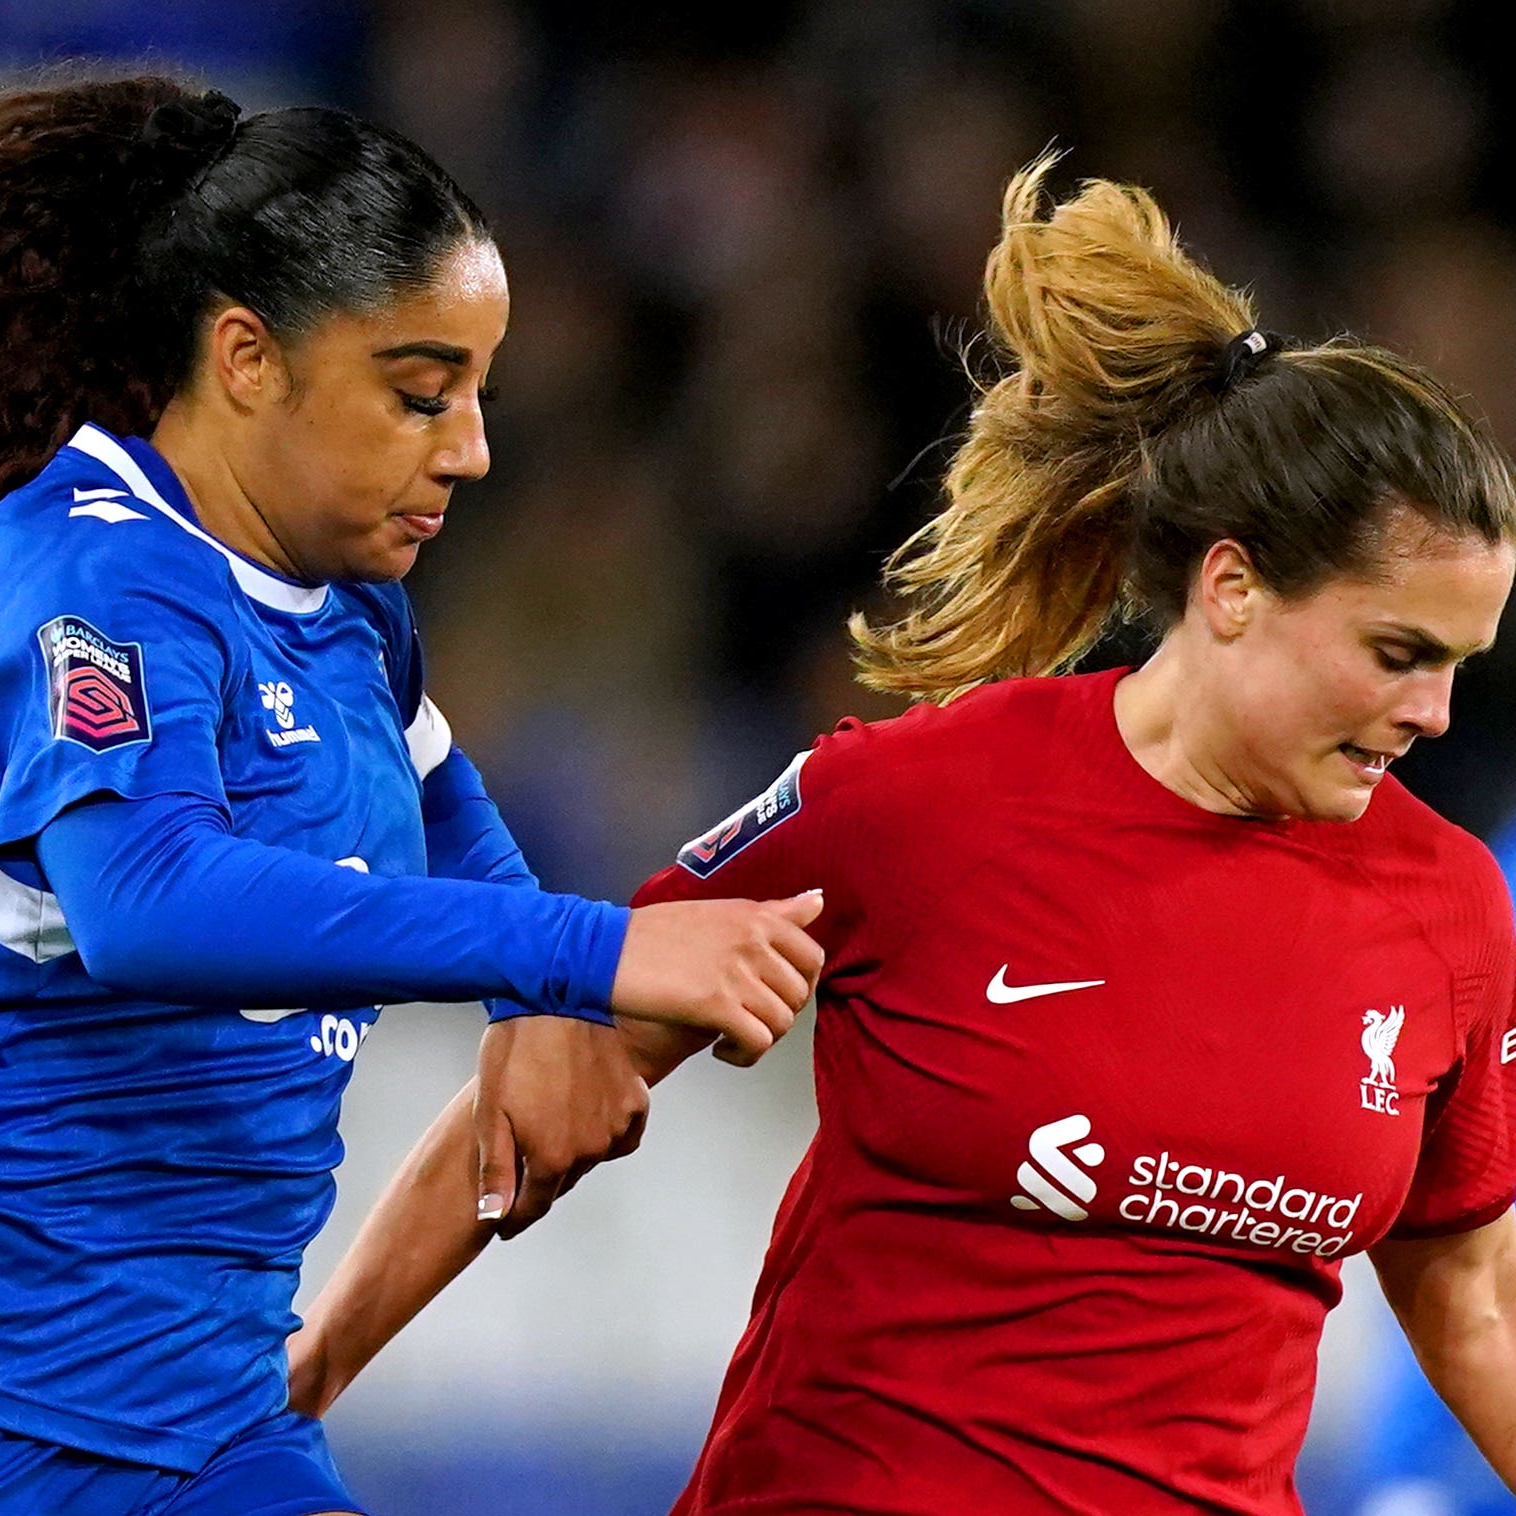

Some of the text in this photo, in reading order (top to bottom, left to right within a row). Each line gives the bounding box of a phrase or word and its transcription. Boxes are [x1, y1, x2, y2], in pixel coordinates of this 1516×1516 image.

[65, 624, 130, 663] BARCLAYS
[266, 724, 322, 748] hummel
[1128, 1150, 1364, 1230] standard
[1118, 1189, 1354, 1258] chartered
